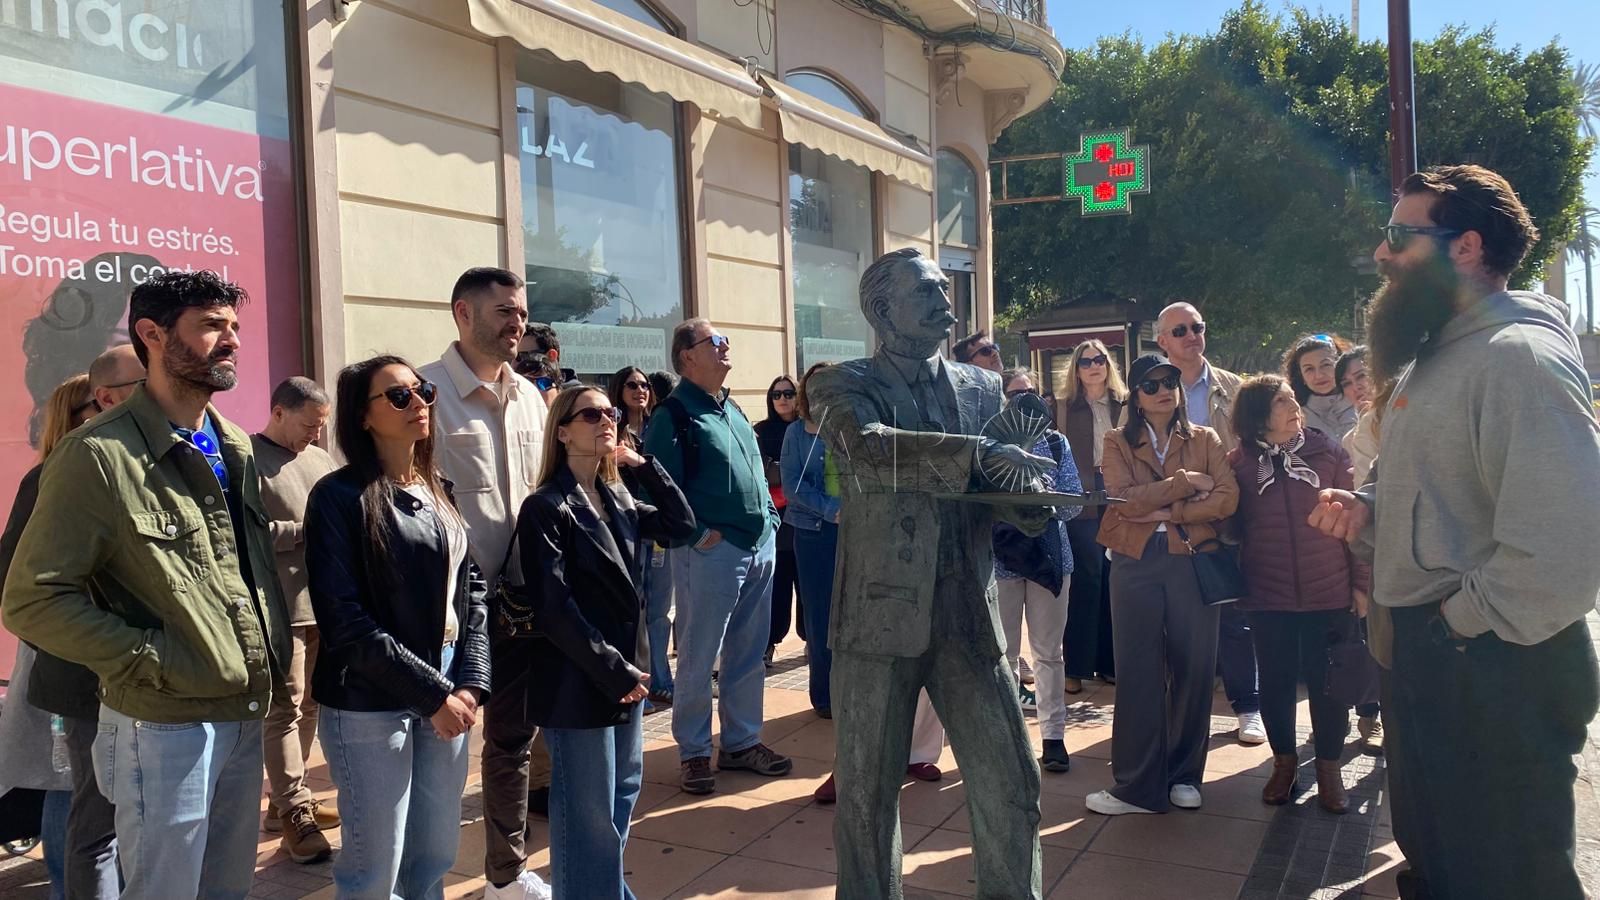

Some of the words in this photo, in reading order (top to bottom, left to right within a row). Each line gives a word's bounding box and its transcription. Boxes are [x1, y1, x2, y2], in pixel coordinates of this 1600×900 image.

[109, 217, 138, 246] tu
[147, 227, 240, 256] estrés.
[0, 245, 86, 281] Toma
[95, 255, 122, 283] el
